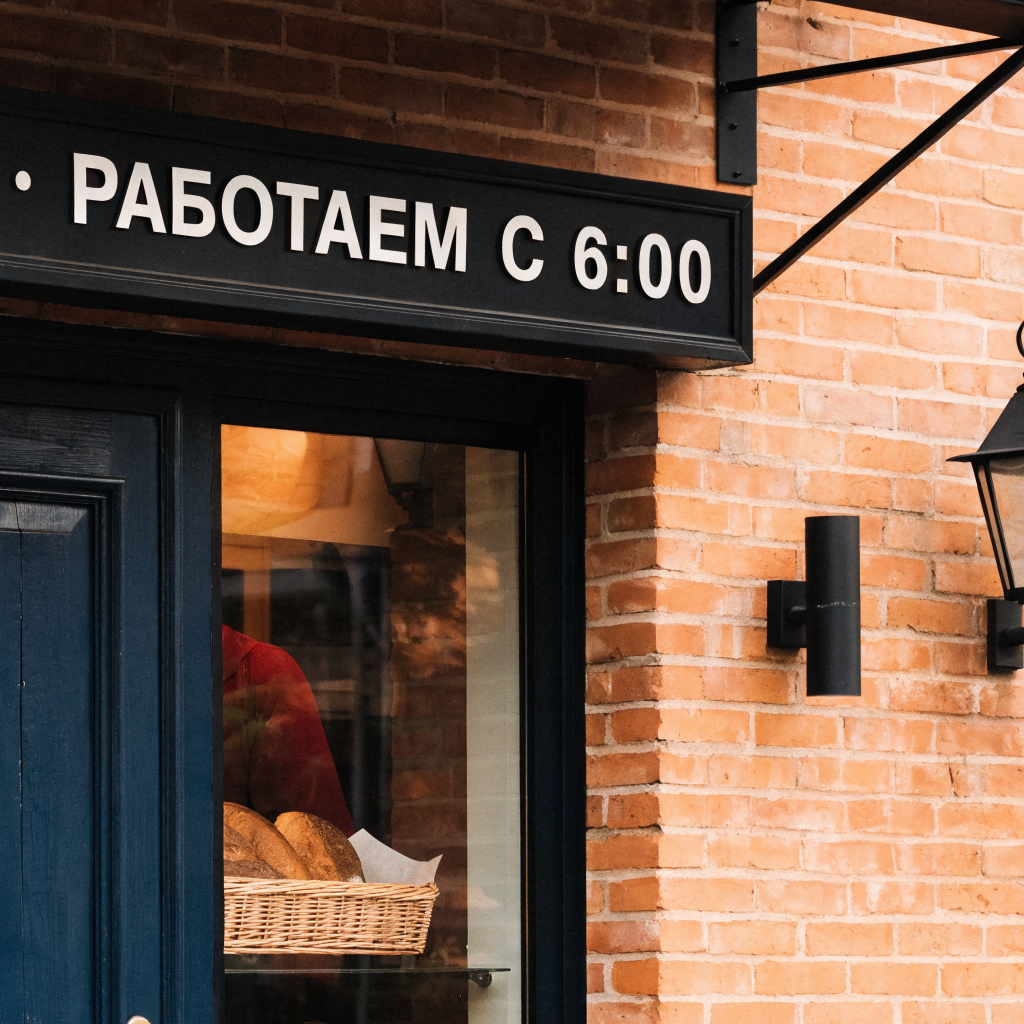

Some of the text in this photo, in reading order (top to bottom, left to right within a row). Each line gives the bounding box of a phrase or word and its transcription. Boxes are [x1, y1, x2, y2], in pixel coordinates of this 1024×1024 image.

[73, 152, 468, 273] РАБОТАЕМ
[501, 214, 544, 282] С
[574, 225, 712, 304] 6:00
